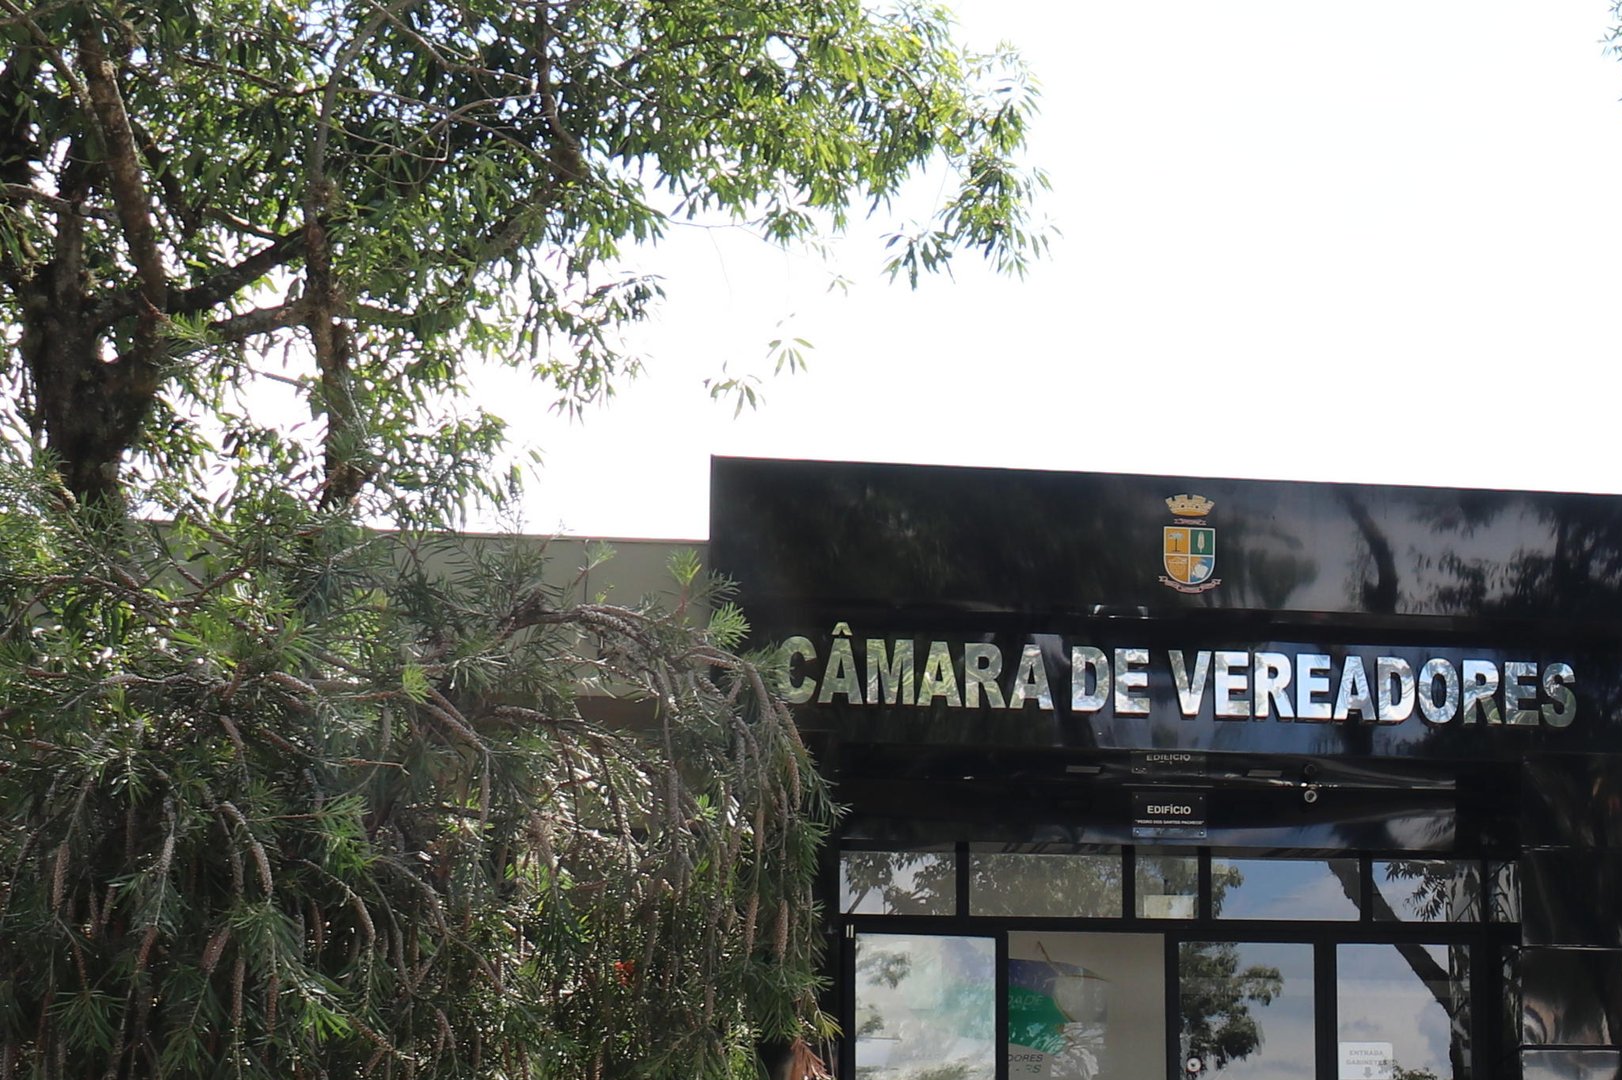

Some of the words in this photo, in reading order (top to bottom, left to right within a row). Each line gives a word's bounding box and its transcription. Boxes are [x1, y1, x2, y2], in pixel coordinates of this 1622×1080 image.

[778, 622, 1053, 710] CÂMARA
[1071, 646, 1150, 714] DE
[1167, 650, 1577, 727] VEREADORES
[1147, 804, 1192, 815] EDIFÍCIO
